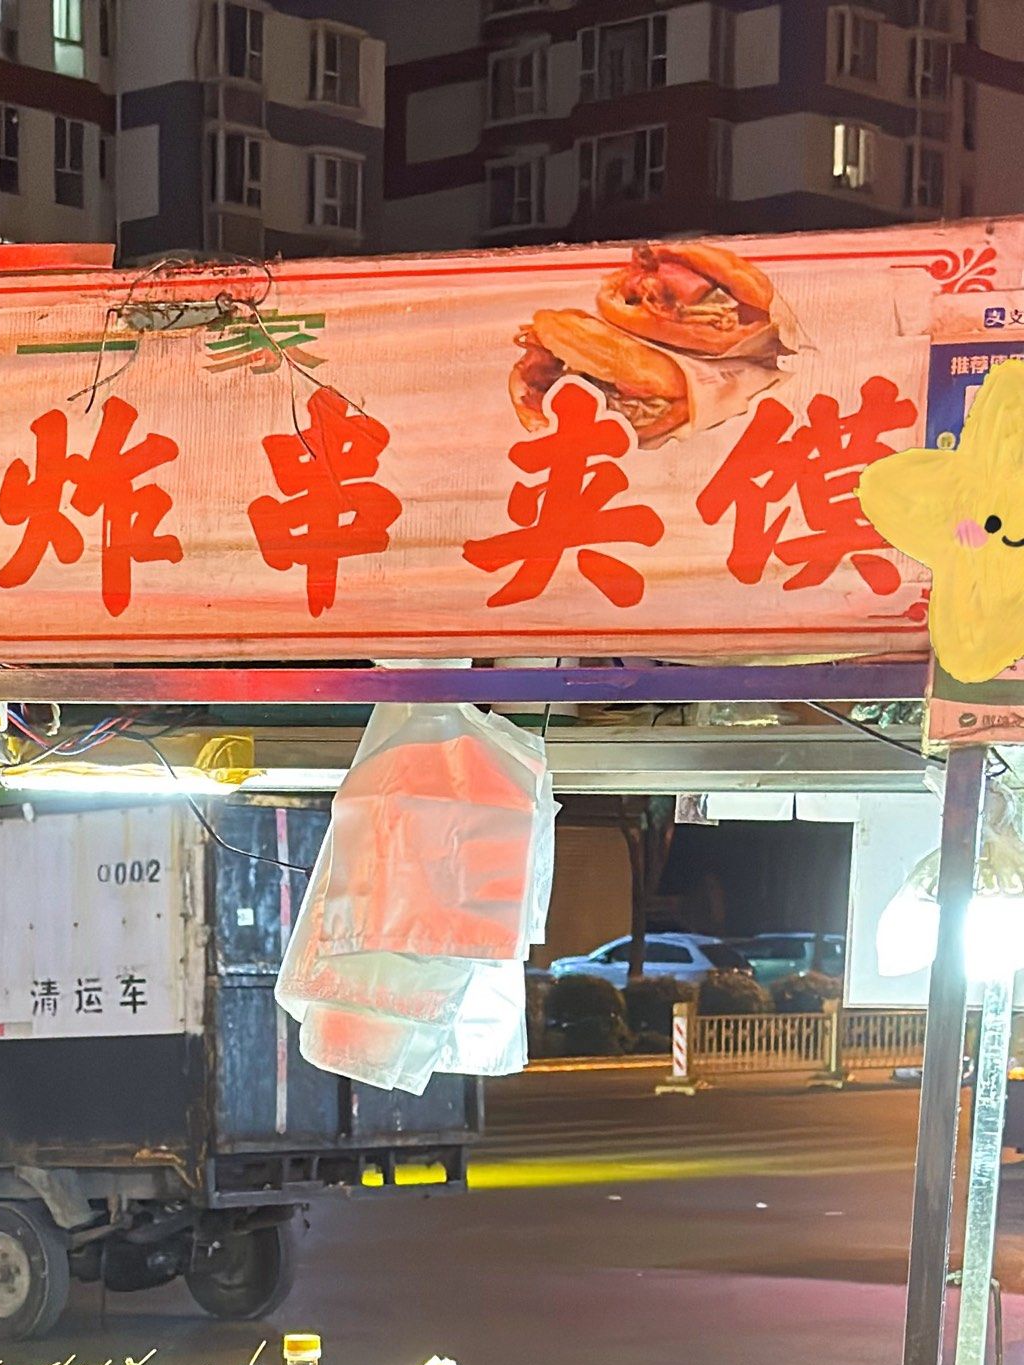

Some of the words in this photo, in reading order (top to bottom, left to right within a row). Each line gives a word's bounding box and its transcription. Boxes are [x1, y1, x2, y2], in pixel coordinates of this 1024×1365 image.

[97, 859, 161, 885] 0002
[30, 975, 148, 1016] 清运车
